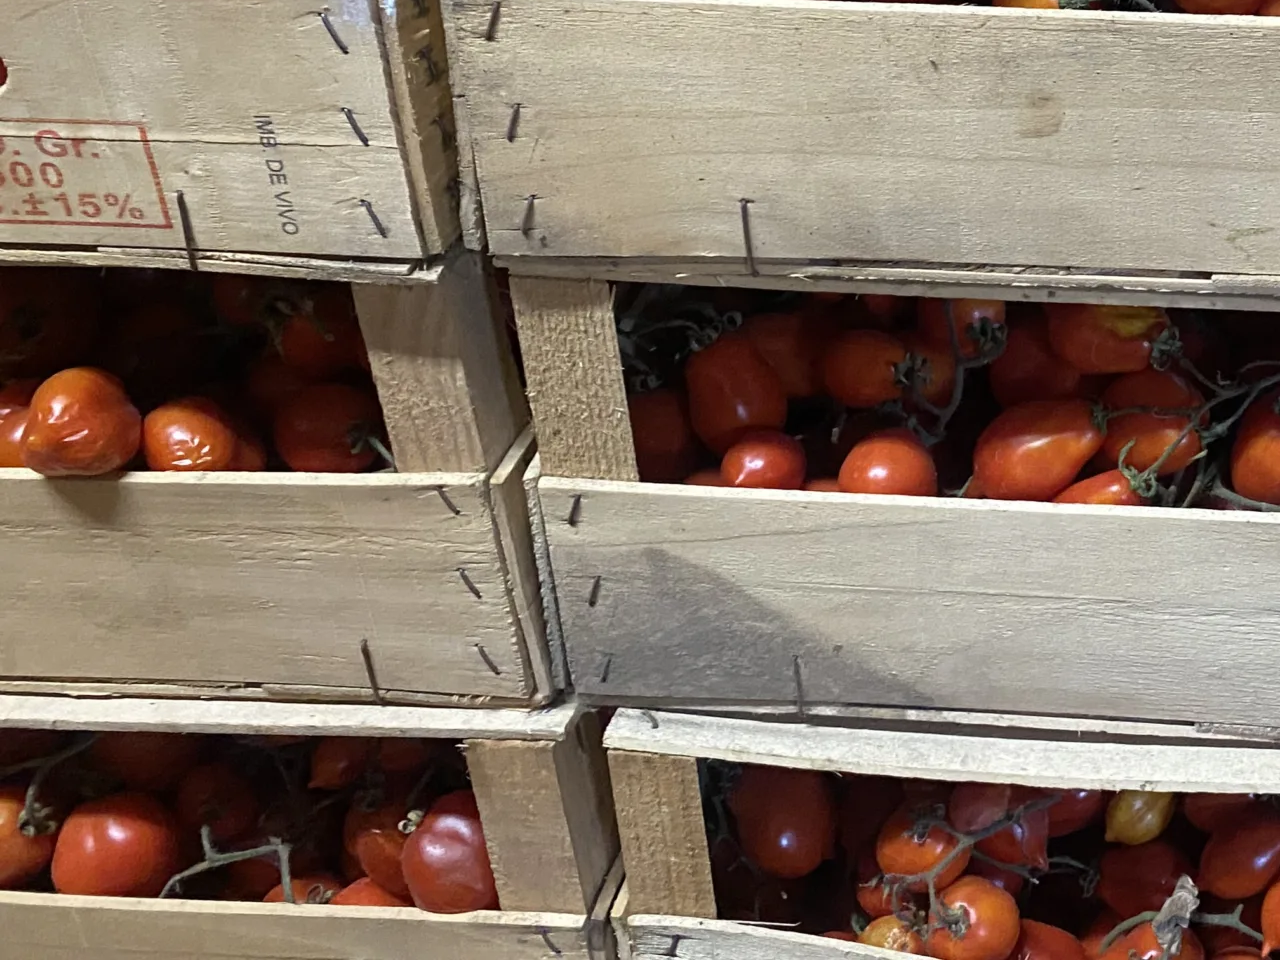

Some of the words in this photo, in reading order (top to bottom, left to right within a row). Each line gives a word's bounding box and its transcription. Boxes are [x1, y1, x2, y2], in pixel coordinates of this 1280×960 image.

[34, 129, 100, 158] Gr.
[253, 114, 278, 152] IMB.
[0, 160, 64, 189] 00
[265, 159, 289, 186] DE
[274, 190, 299, 236] VIVO
